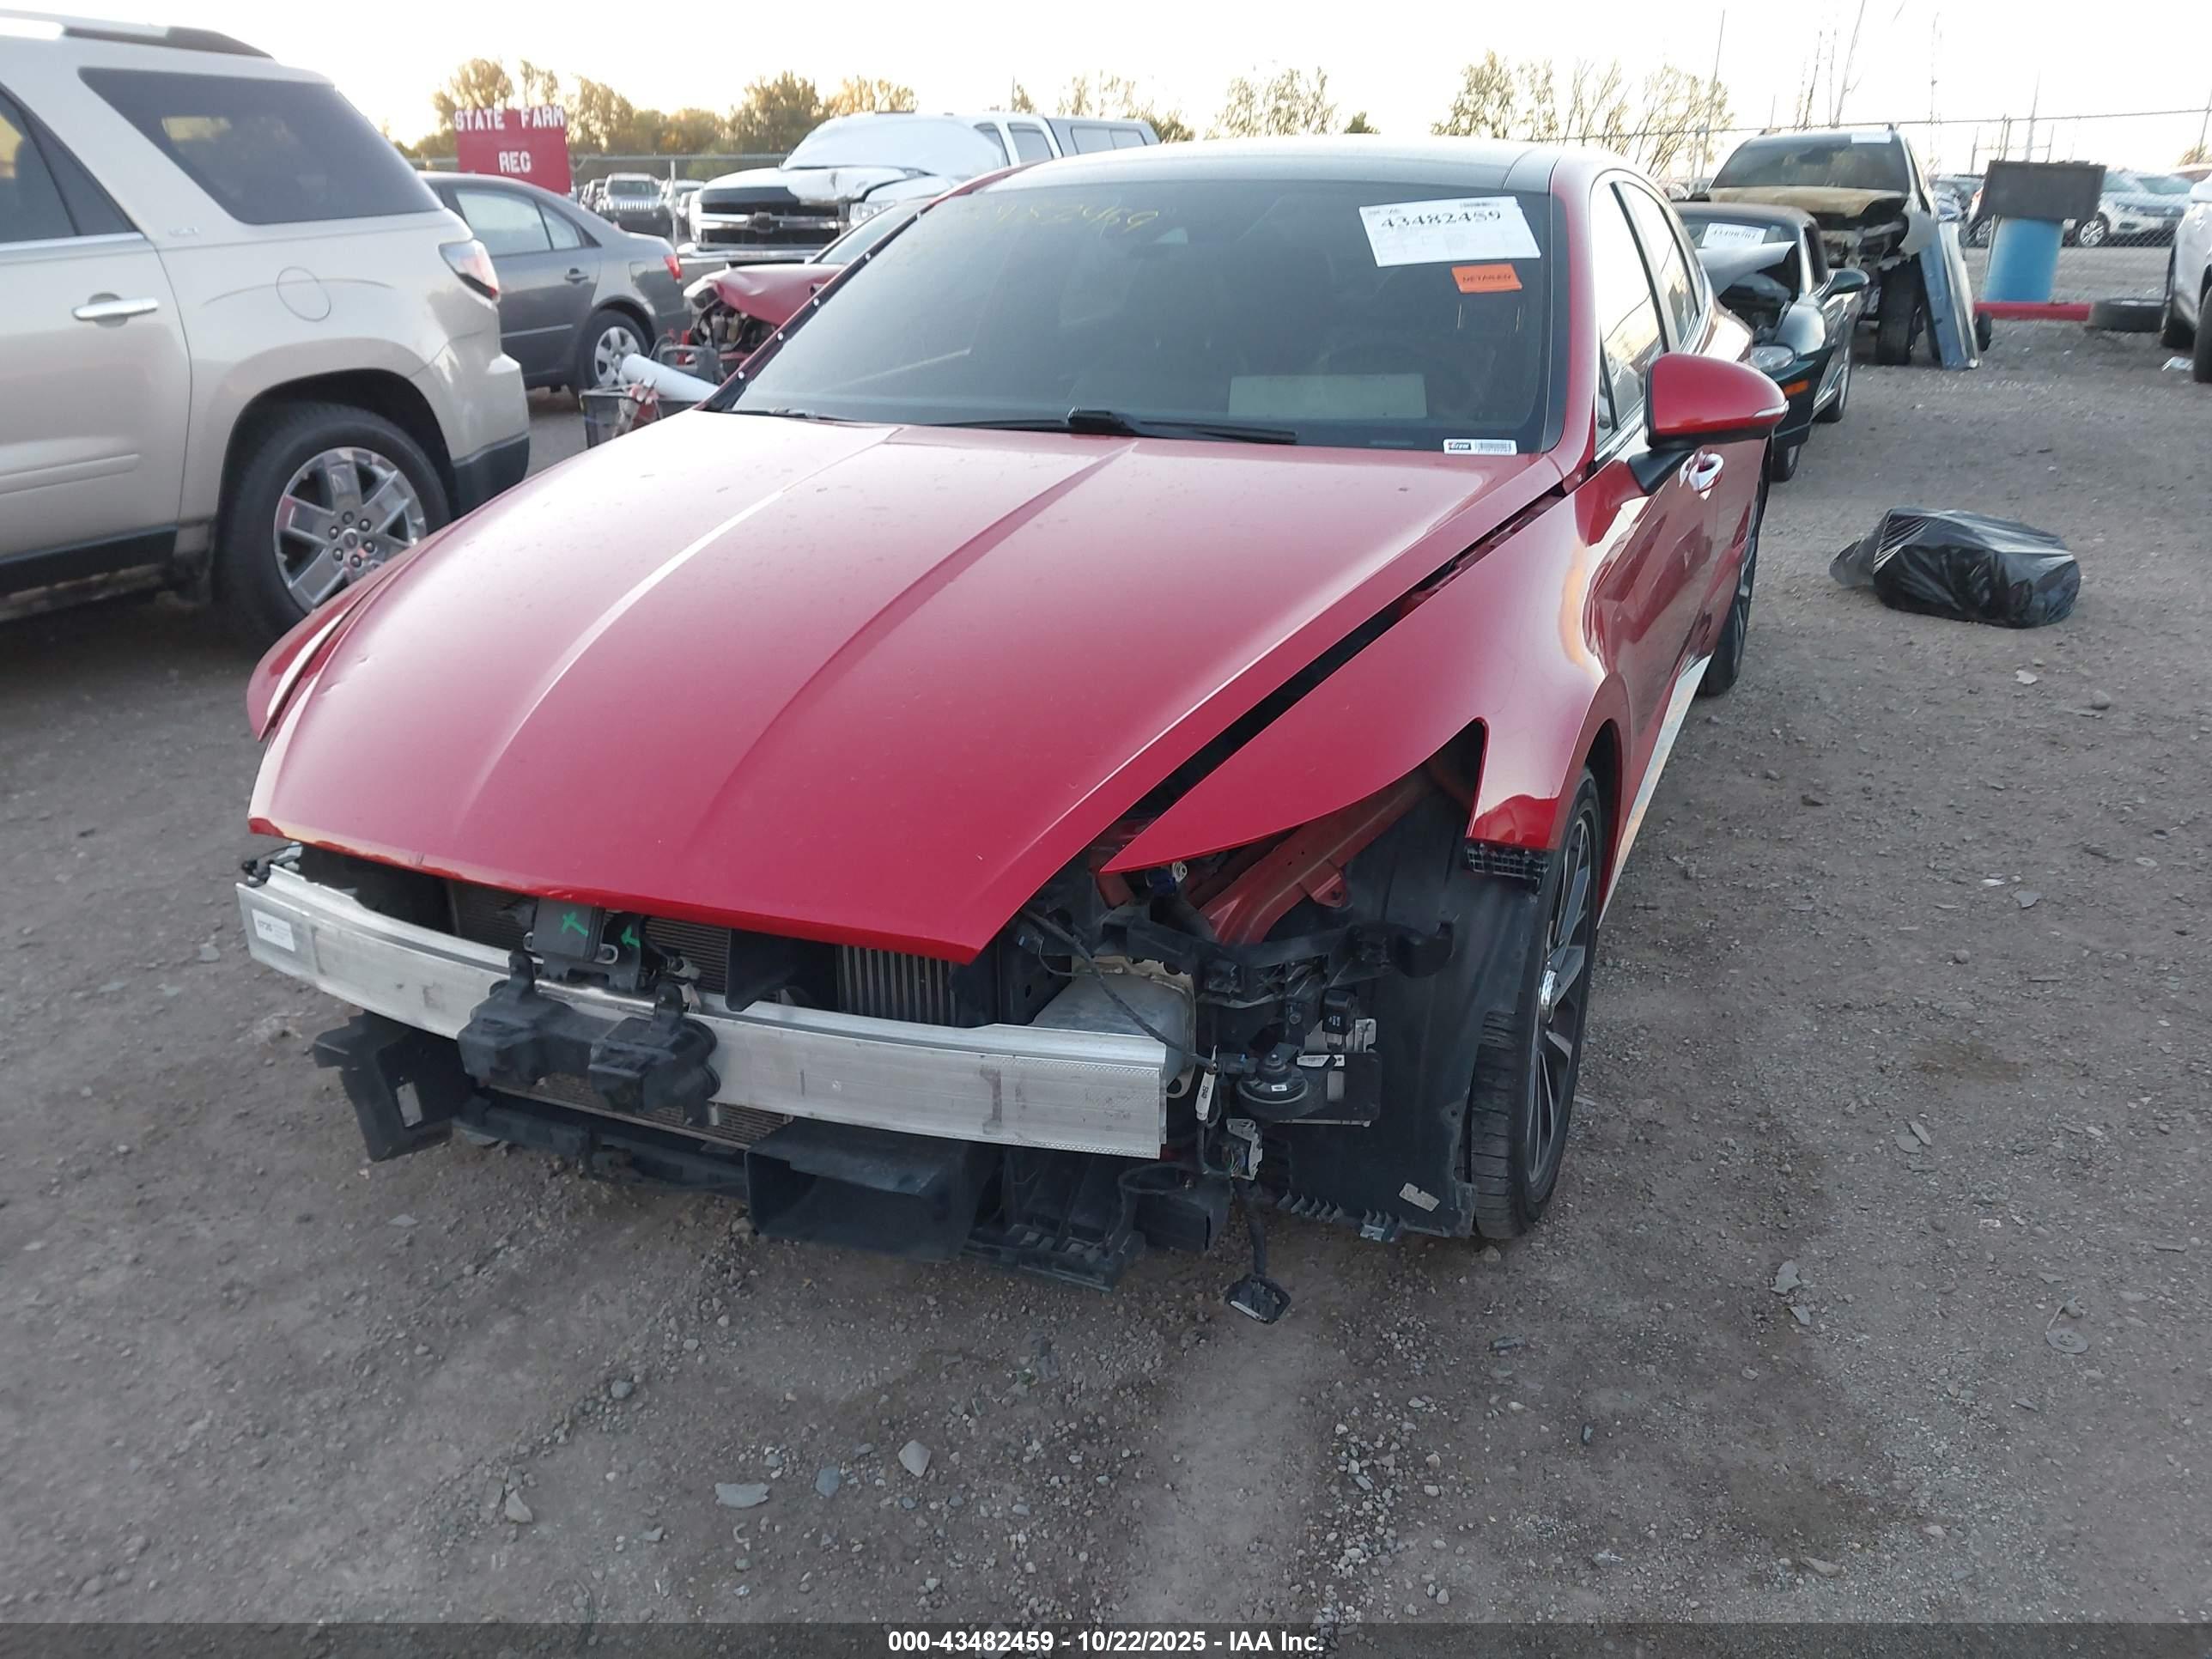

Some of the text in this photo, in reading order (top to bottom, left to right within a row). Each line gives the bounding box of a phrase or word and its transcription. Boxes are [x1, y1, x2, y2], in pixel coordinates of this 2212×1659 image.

[454, 106, 564, 131] STATE FARM
[1381, 210, 1501, 228] 43482459
